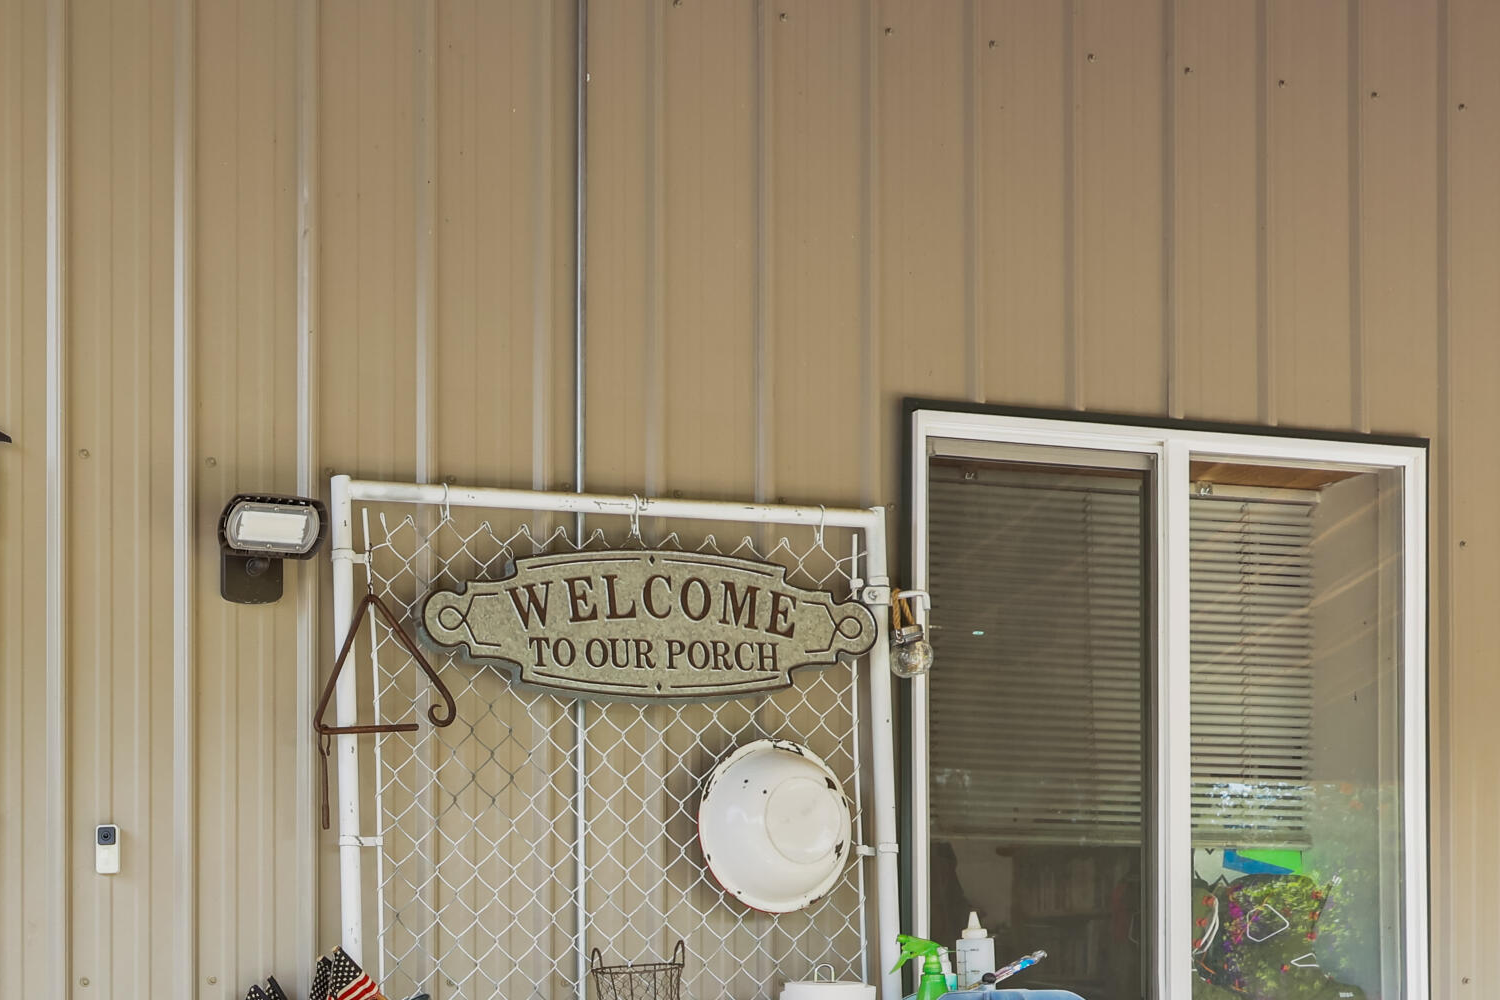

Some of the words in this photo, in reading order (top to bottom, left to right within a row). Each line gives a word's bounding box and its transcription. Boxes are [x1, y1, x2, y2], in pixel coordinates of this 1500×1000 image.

[505, 574, 798, 639] WELCOME
[528, 636, 576, 668] TO
[584, 637, 657, 670] OUR
[666, 639, 781, 673] PORCH
